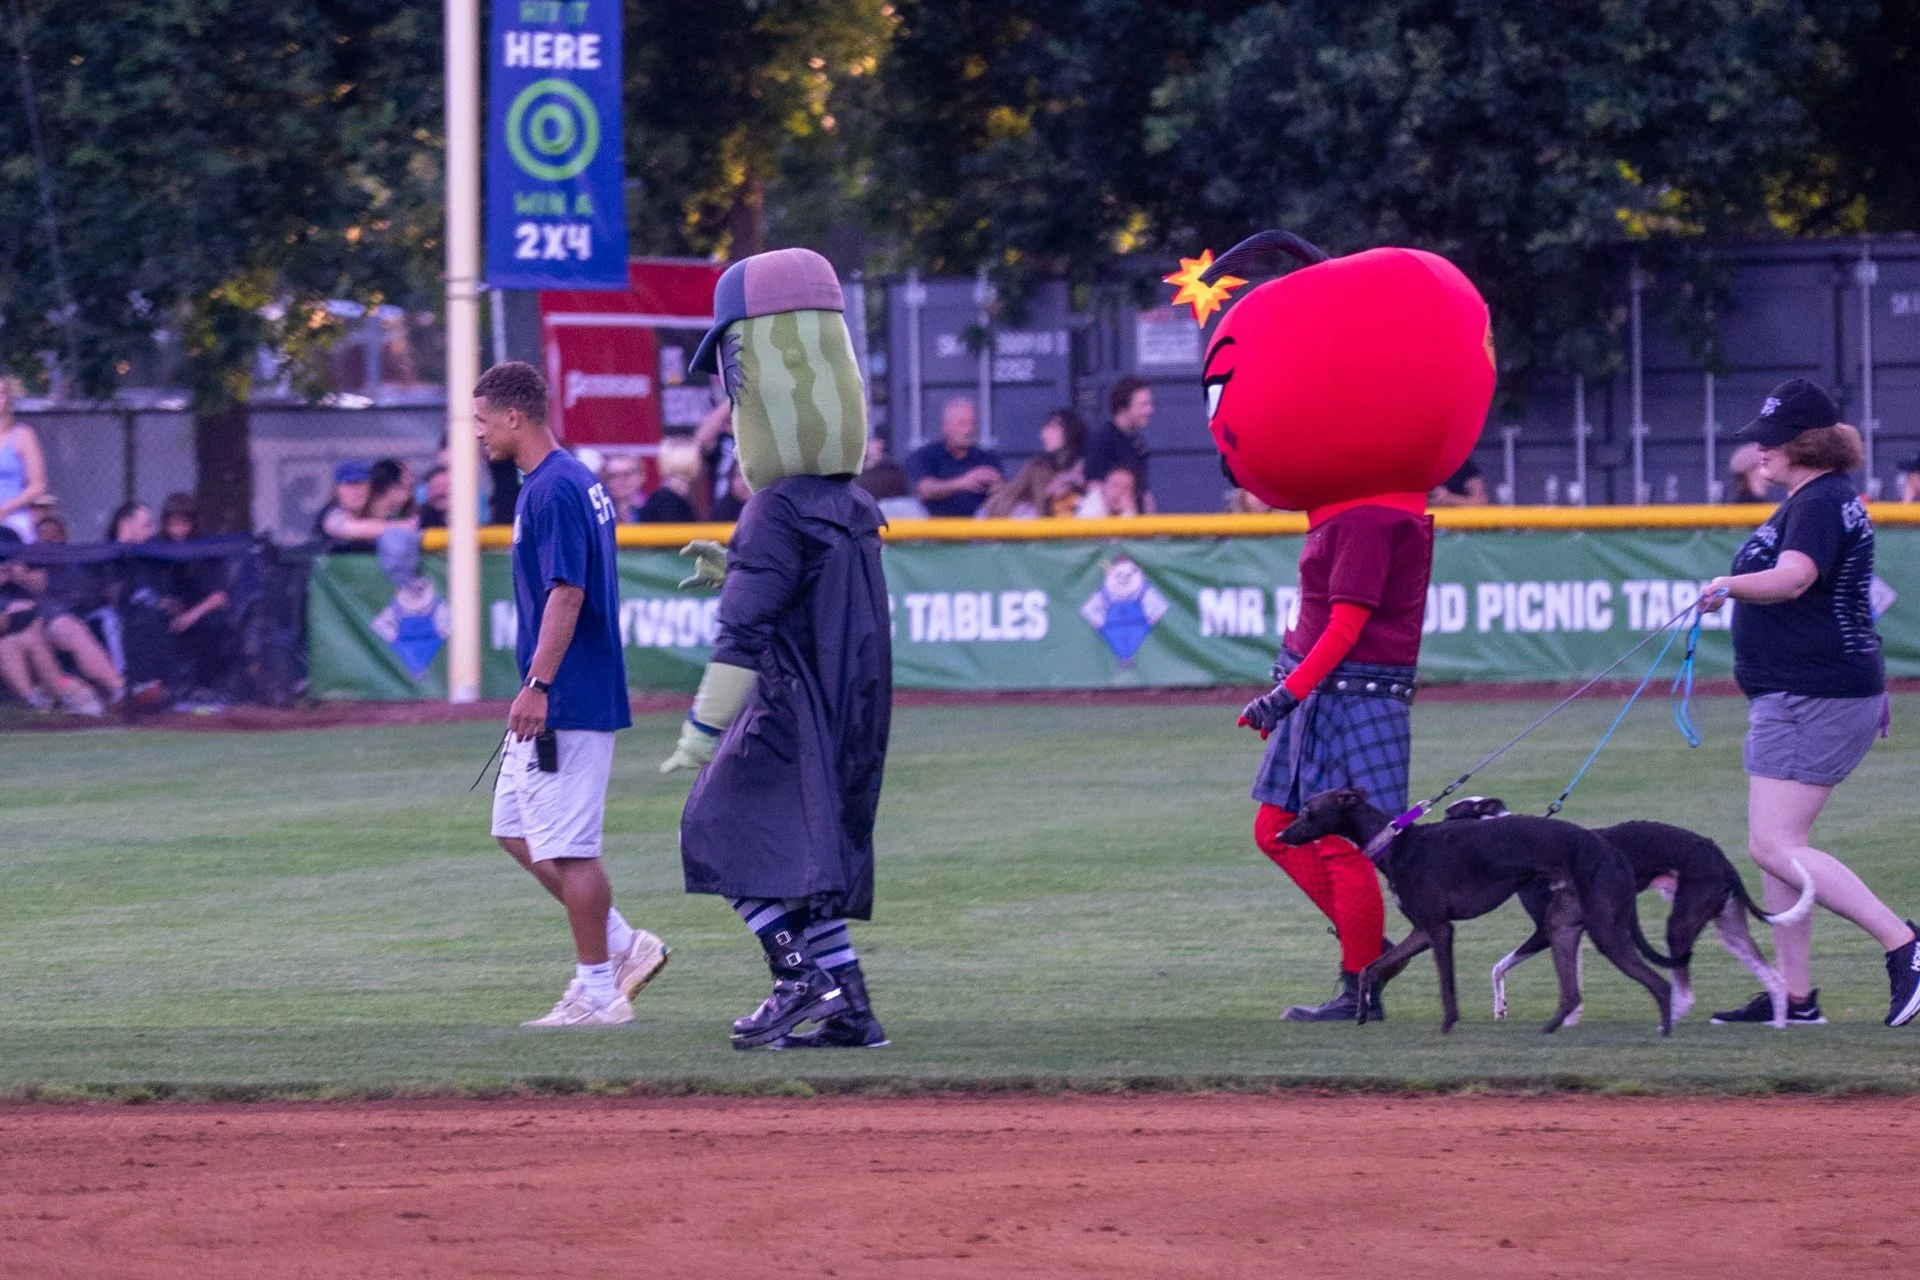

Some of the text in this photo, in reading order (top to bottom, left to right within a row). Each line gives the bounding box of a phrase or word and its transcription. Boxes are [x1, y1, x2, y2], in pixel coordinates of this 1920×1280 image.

[503, 30, 602, 70] HERE
[514, 221, 592, 261] 2X4
[906, 591, 1049, 642] TABLES
[1199, 586, 1265, 637] MR
[1476, 580, 1614, 634] PICNIC
